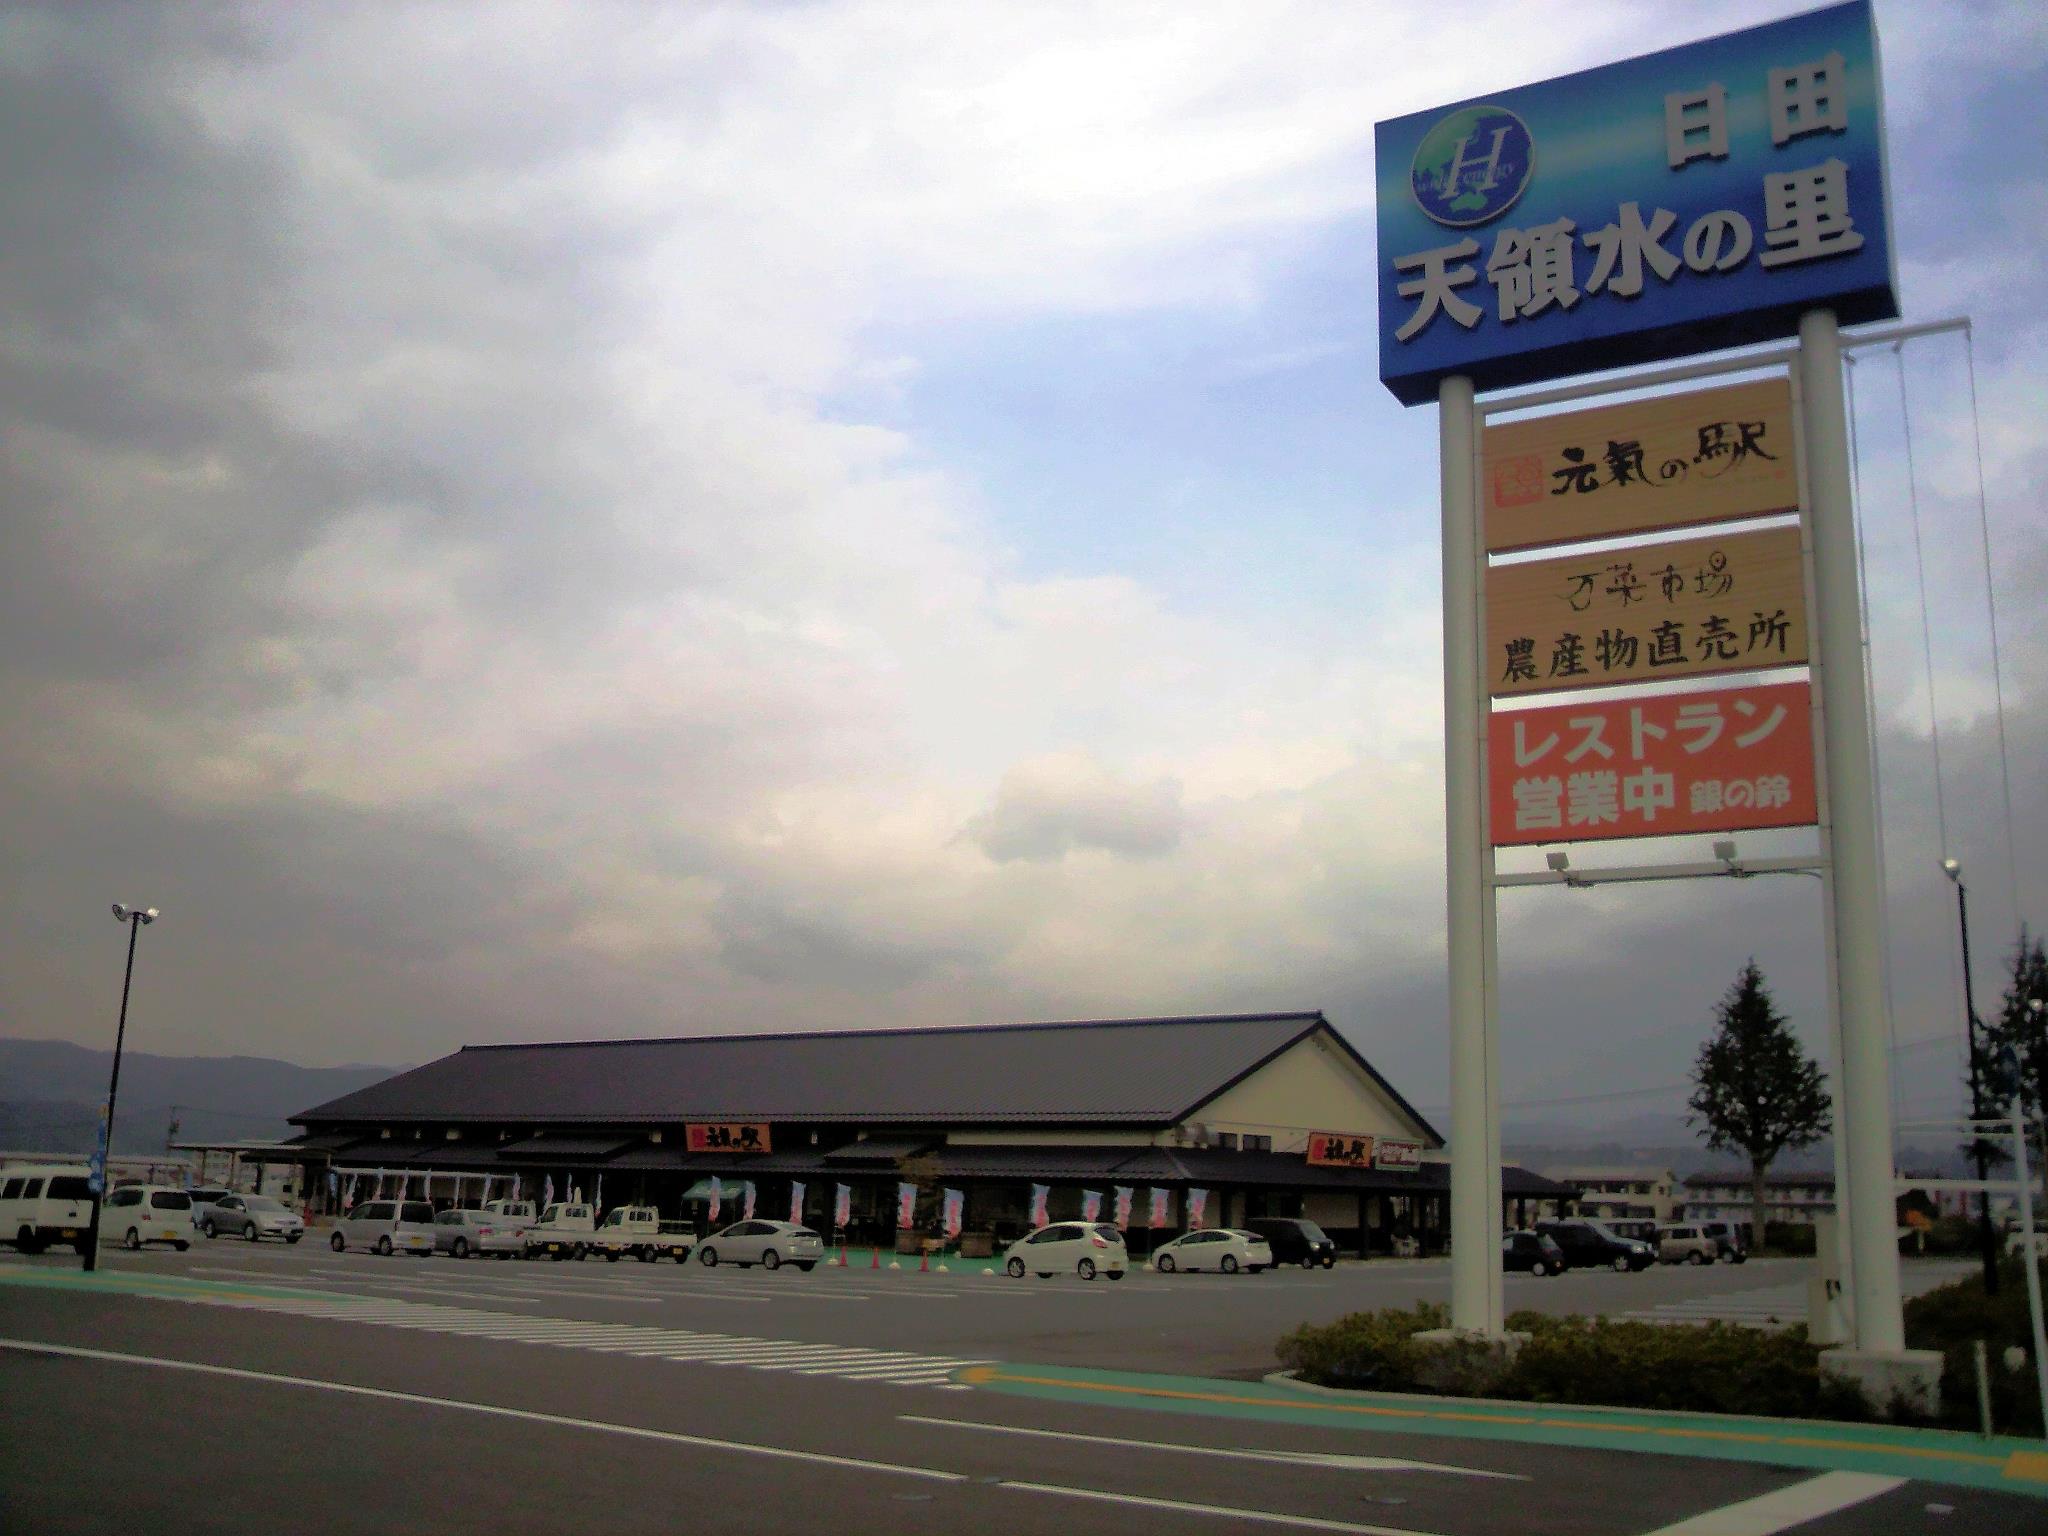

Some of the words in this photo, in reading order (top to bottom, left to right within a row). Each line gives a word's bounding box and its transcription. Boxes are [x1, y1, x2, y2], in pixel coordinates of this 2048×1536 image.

[1665, 50, 1848, 169] 日田
[1439, 126, 1513, 200] H
[1394, 157, 1865, 343] 天領水の里
[1502, 609, 1792, 683] 農産物直売所
[1513, 699, 1788, 768] レストラン
[1512, 766, 1676, 830] 営業中
[1689, 773, 1792, 815] 銀の鈴
